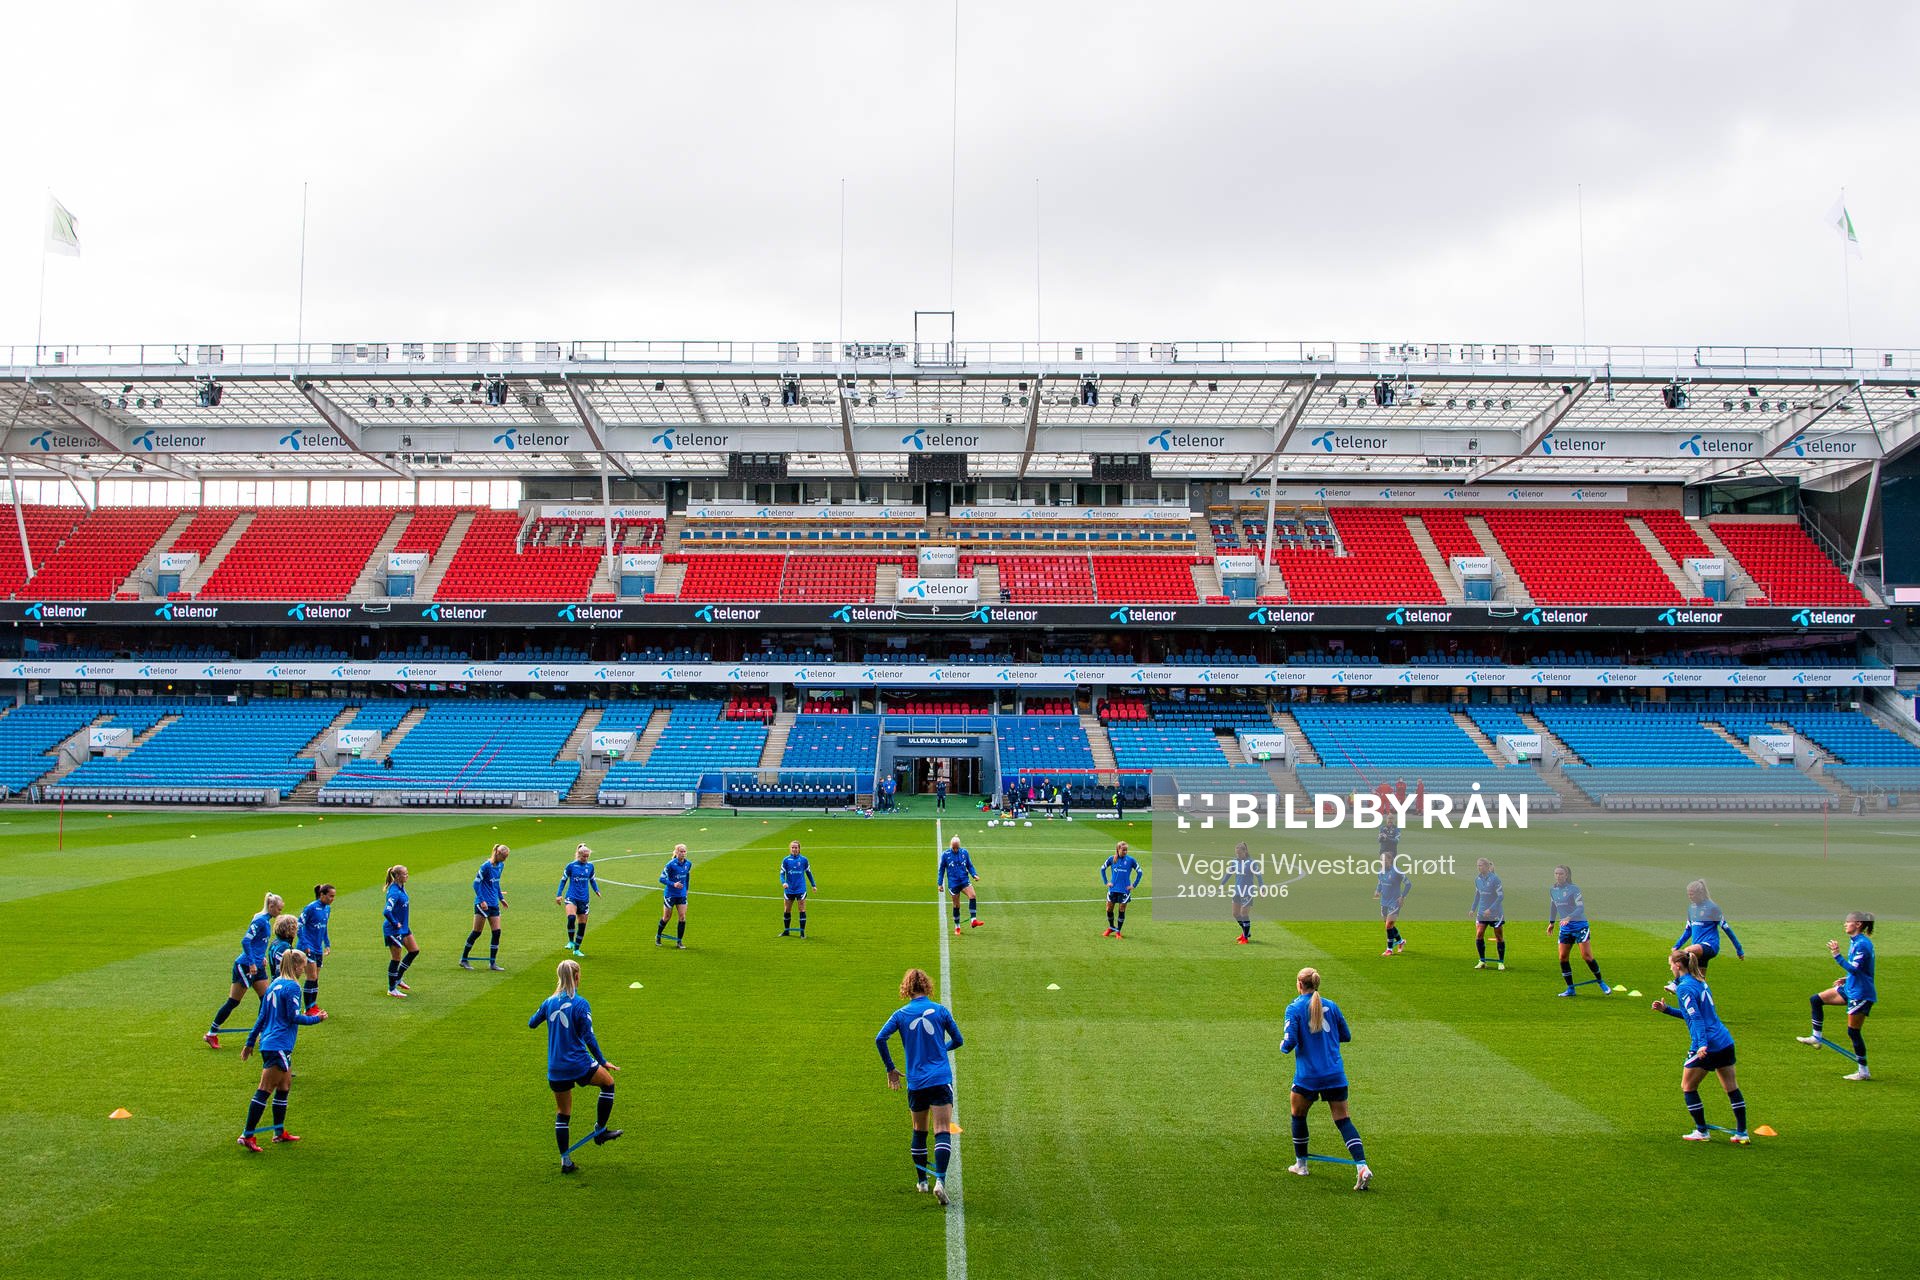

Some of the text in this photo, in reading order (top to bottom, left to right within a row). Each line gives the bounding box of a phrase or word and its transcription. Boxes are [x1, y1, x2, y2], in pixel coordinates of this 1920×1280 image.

[156, 435, 206, 447] telenor
[303, 434, 347, 447] teleno
[518, 433, 569, 446] telenor
[676, 433, 728, 446] telenor
[926, 433, 979, 446] telenor
[1172, 434, 1225, 447] telenor
[1336, 435, 1388, 448] telenor
[1554, 438, 1606, 451] telenor
[1703, 439, 1753, 452] telenor
[1807, 440, 1856, 453] telenor
[1261, 488, 1287, 498] telnor
[1326, 488, 1351, 498] telenor
[1390, 488, 1416, 498] telenor
[1455, 488, 1480, 498] telenor
[1518, 488, 1544, 498] telenor
[1582, 488, 1607, 498] telenor
[568, 508, 594, 517] telenor
[625, 508, 651, 517] telenor
[707, 508, 734, 518] telenor
[767, 508, 795, 518] telenor
[828, 508, 855, 518] telenor
[889, 508, 916, 518] telenor
[969, 510, 997, 519] telenor
[1031, 510, 1058, 519] telenor
[1092, 510, 1119, 519] telenor
[932, 552, 955, 560] telenor
[172, 558, 192, 566] teleno
[926, 584, 968, 594] telenor
[43, 605, 87, 617] telenor
[173, 605, 218, 618] telenor
[306, 606, 351, 618] telenor
[440, 607, 486, 619] telenor
[576, 607, 623, 619] telenor
[714, 607, 760, 619] telenor
[852, 608, 898, 620] telenor
[991, 608, 1037, 620] telenor
[1129, 608, 1176, 621] telenor
[1268, 610, 1314, 622] telenor
[1406, 610, 1451, 622] telenor
[1542, 611, 1588, 623] telenor
[1677, 611, 1722, 623] telenor
[1810, 611, 1855, 624] telenor
[24, 666, 51, 674] telenor
[87, 666, 114, 674] telenor
[150, 666, 178, 675] telenor
[215, 667, 242, 675] telenor
[279, 667, 306, 675] telenor
[343, 667, 371, 676] telenor
[409, 668, 437, 676] telenor
[474, 668, 502, 677] telenor
[541, 668, 569, 677] telenor
[607, 669, 635, 677] telenor
[673, 669, 702, 677] telenor
[740, 669, 769, 678] telenor
[807, 669, 836, 678] telenor
[874, 670, 903, 678] telenor
[942, 670, 970, 678] telenor
[1009, 670, 1037, 678] telenor
[1076, 670, 1104, 679] telenor
[1143, 670, 1172, 679] telenor
[1210, 671, 1239, 680] telenor
[1277, 671, 1306, 680] telenor
[1344, 672, 1373, 680] telenor
[1411, 672, 1439, 680] telenor
[1478, 672, 1506, 681] telenor
[1543, 673, 1571, 682] telenor
[1609, 673, 1637, 682] telenor
[1674, 673, 1702, 682] telenor
[1738, 674, 1766, 682] telenor
[1803, 674, 1831, 682] telenor
[1864, 674, 1891, 682] telenor
